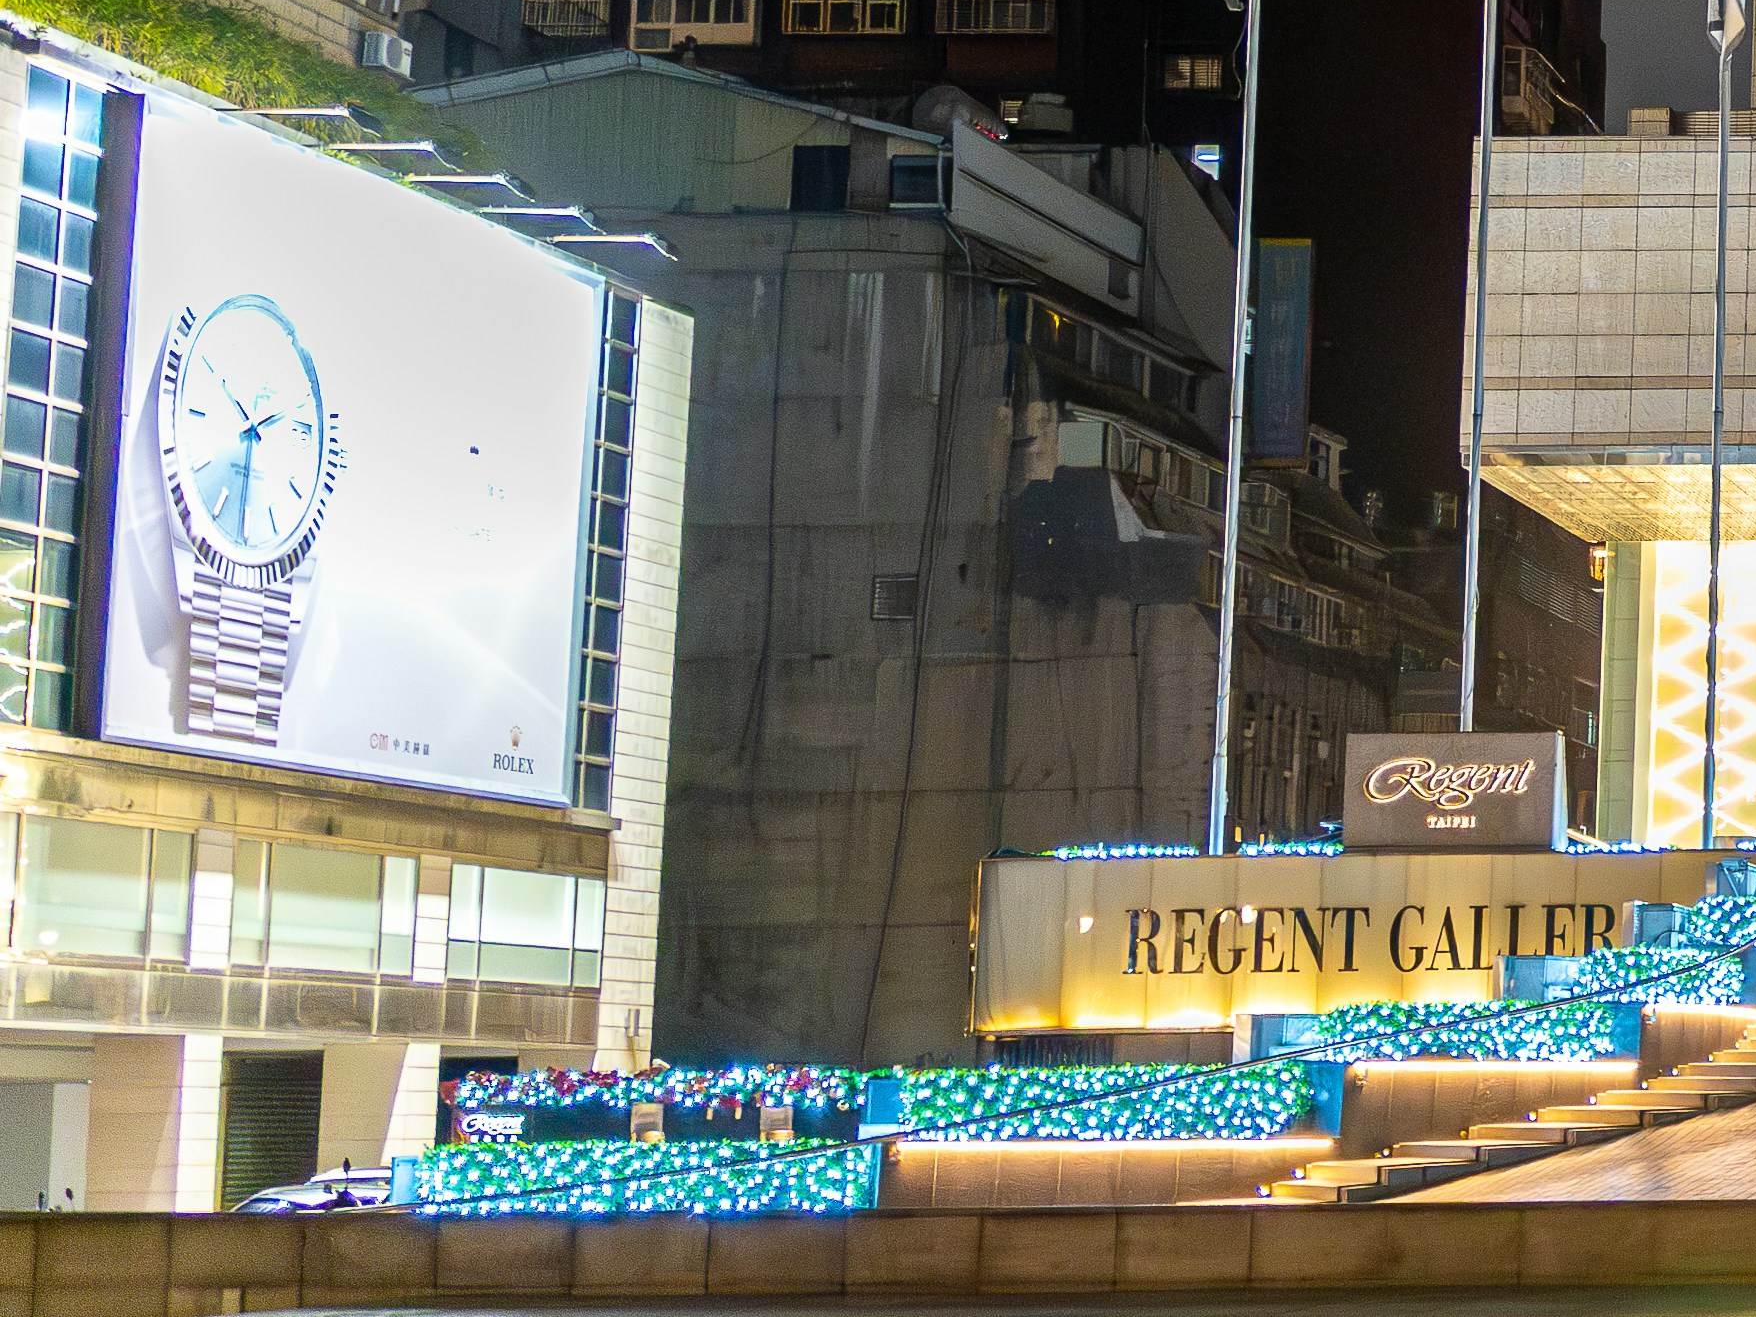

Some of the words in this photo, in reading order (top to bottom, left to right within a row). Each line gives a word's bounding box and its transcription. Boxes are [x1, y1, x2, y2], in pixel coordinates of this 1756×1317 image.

[493, 753, 534, 775] ROLEX
[1363, 757, 1536, 810] Regent
[1427, 815, 1476, 829] TAIPEI
[1122, 905, 1371, 975] REGENT
[1389, 903, 1617, 973] GALLER
